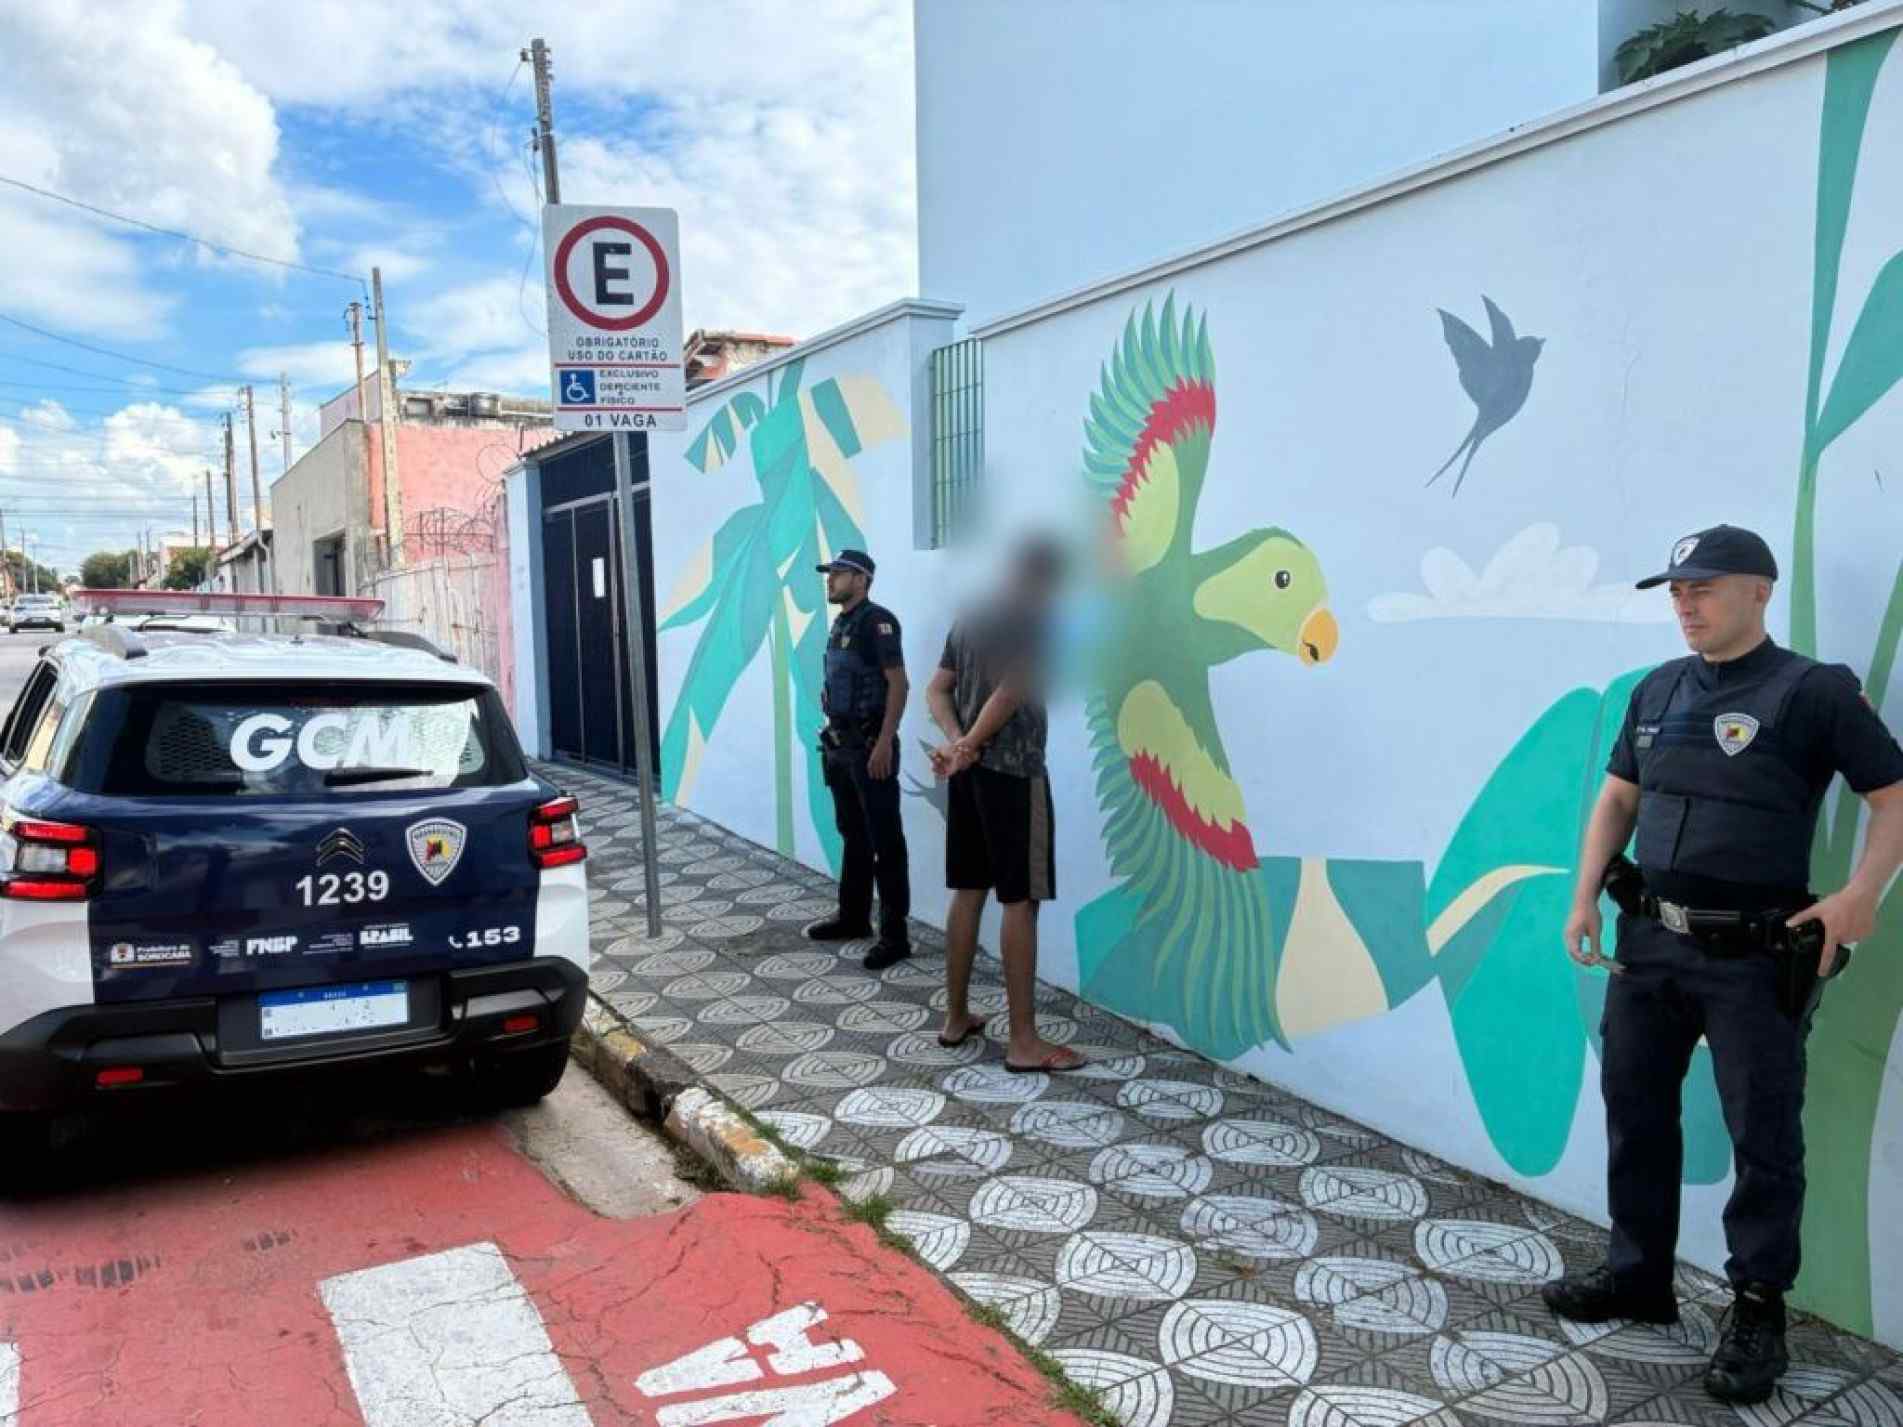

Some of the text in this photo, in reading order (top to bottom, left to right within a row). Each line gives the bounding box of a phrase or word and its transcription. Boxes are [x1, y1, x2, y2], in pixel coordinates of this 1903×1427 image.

[592, 241, 634, 306] E
[567, 349, 668, 361] USO DO CARTÃO
[599, 369, 659, 379] EXCLUSIVO
[599, 382, 661, 392] DEFICIENTE
[584, 413, 657, 428] 01 VAGA
[230, 712, 412, 772] GCM
[296, 869, 390, 907] 1239
[246, 935, 298, 956] FNSP
[466, 925, 521, 949] 153
